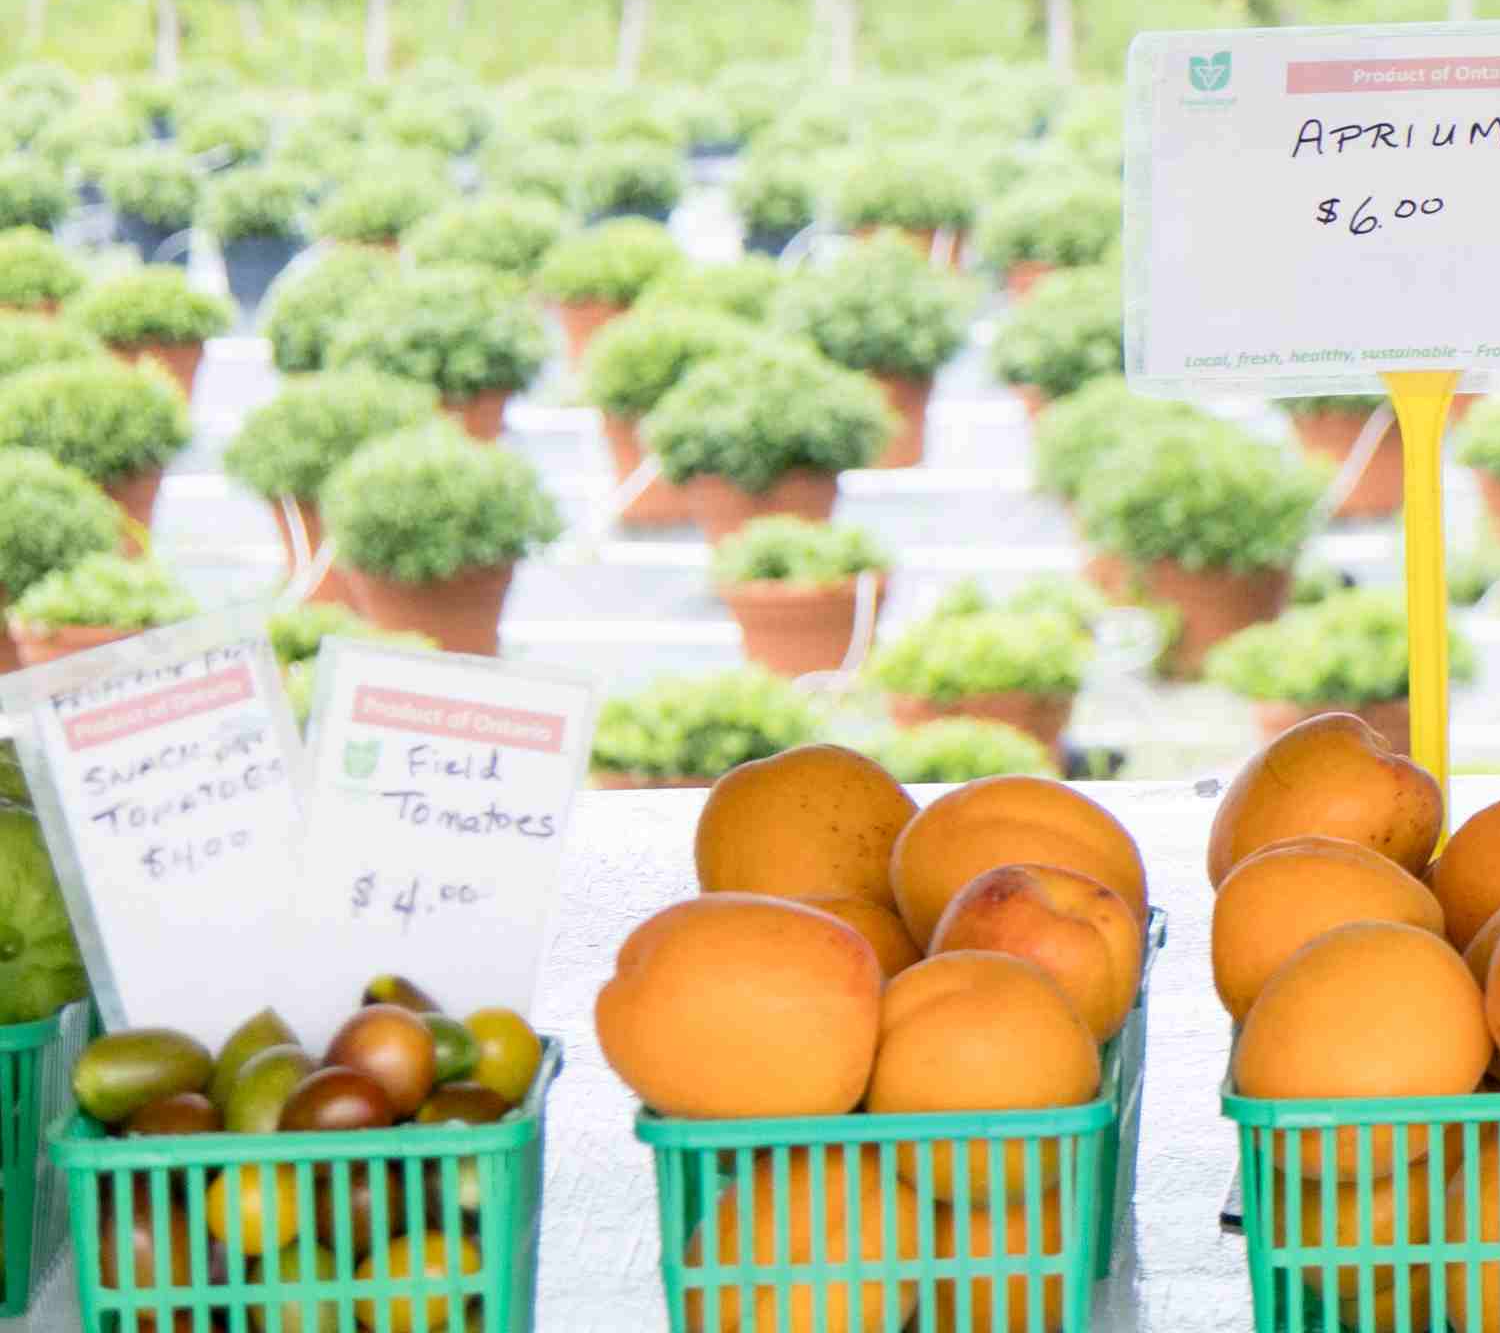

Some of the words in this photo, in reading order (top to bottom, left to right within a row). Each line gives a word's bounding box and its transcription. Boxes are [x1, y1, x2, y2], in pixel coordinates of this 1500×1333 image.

[1352, 64, 1424, 85] Product
[1431, 62, 1450, 81] of
[1184, 353, 1232, 371] Local,
[1235, 350, 1284, 369] fresh,
[1289, 346, 1356, 365] healthy,
[1360, 344, 1458, 361] sustainable
[408, 743, 503, 781] Field
